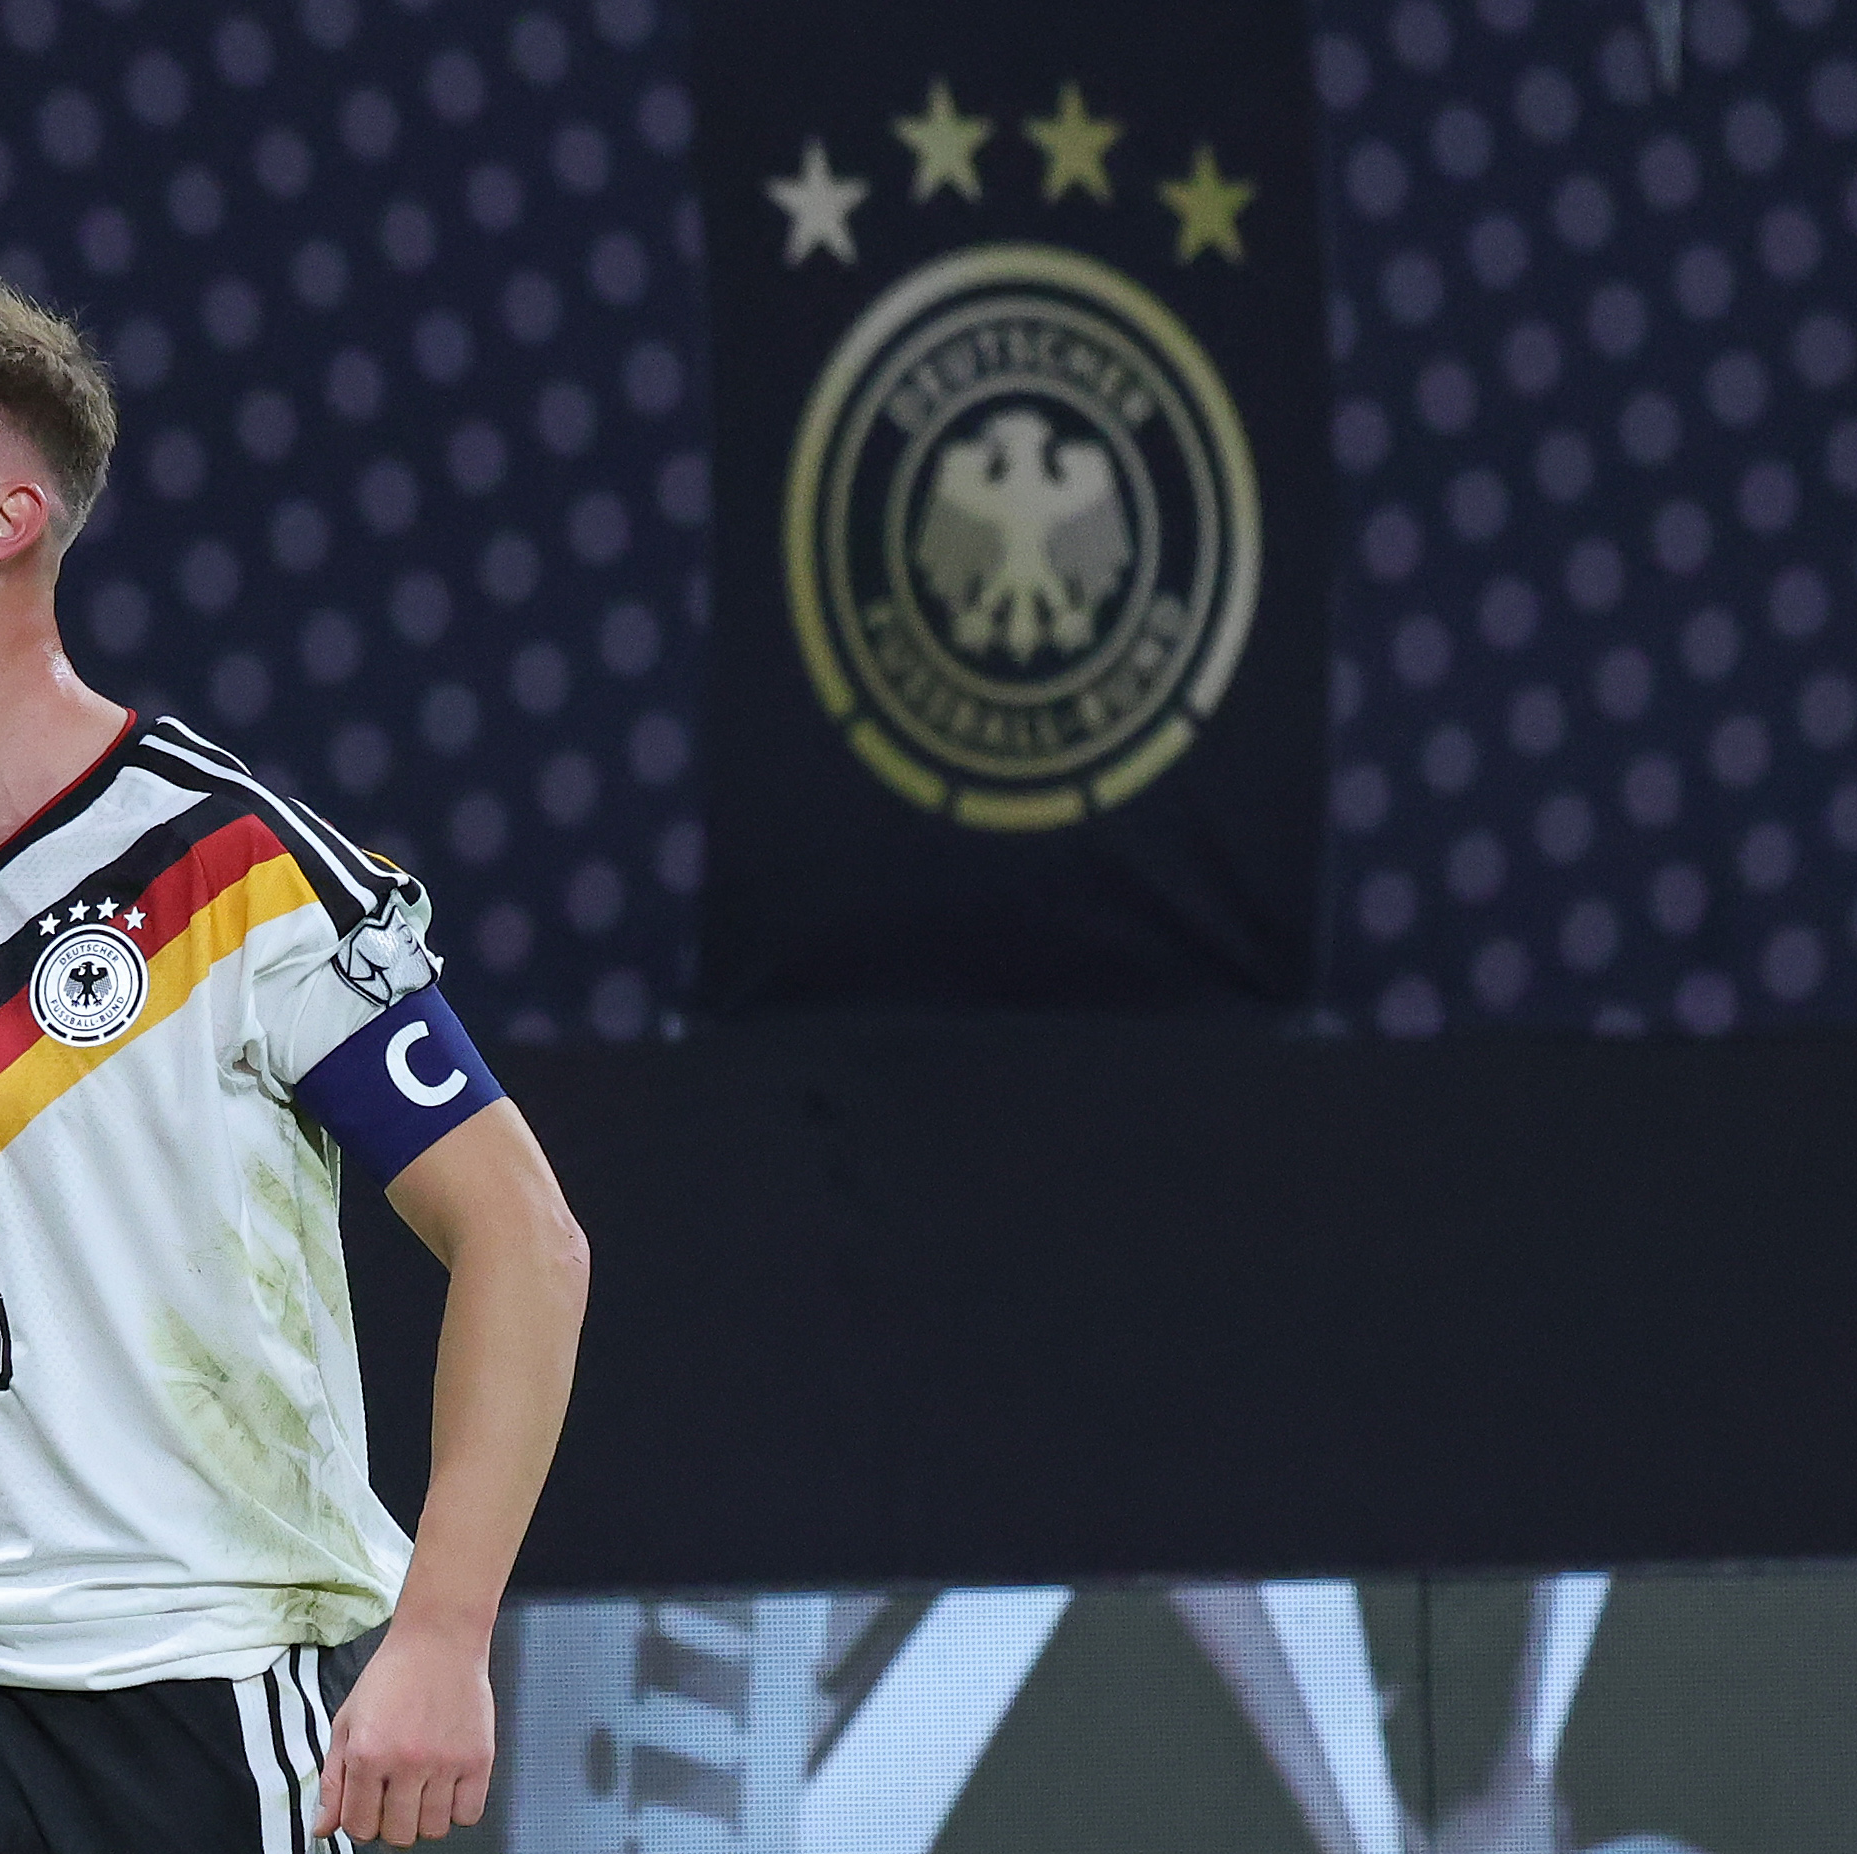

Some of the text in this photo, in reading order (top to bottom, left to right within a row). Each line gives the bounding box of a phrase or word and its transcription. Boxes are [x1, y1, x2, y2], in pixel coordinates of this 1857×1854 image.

[59, 944, 119, 966] DEUTSCHER
[50, 996, 125, 1028] FUSSBALL-BUND
[386, 1020, 468, 1107] C
